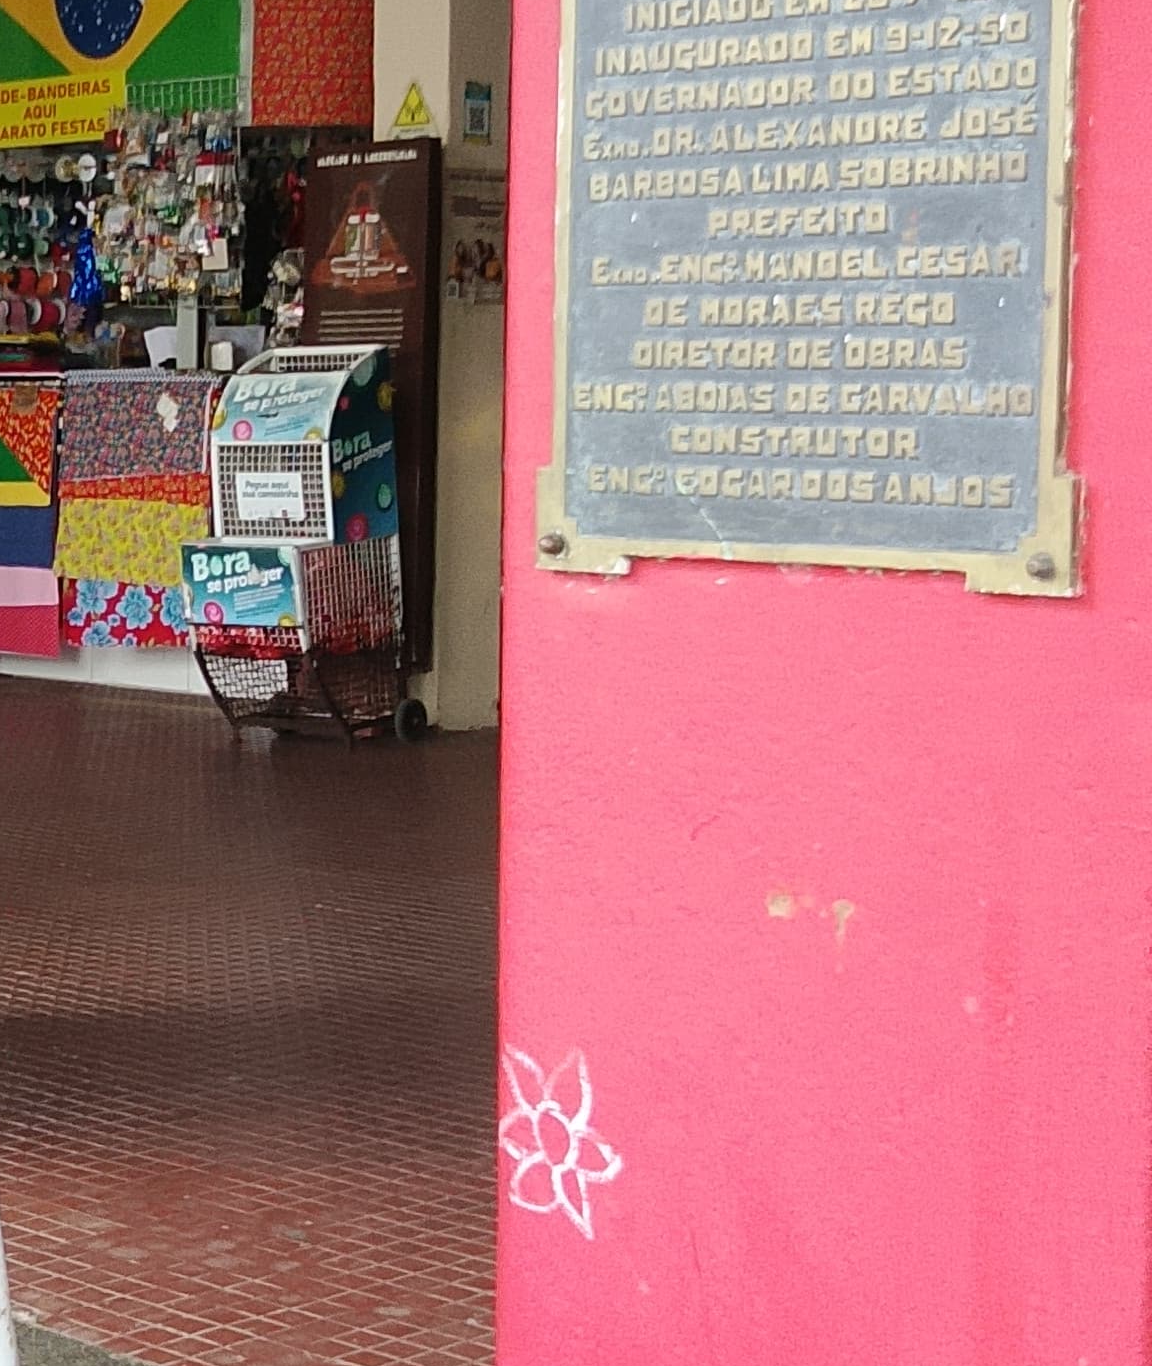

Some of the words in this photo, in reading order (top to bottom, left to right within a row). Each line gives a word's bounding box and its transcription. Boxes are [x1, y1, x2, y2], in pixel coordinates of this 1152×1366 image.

[594, 29, 814, 78] INAUGURADO
[826, 24, 873, 59] EM
[884, 11, 1030, 54] 9-12-50
[584, 72, 815, 121] GOVERNADOR
[828, 68, 876, 103] DO
[887, 57, 1038, 99] ESTADO
[23, 105, 58, 121] AQUI
[51, 117, 106, 137] FESTAS
[710, 106, 928, 155] ALEXANDRE
[939, 90, 1038, 140] JOSÉ
[589, 164, 745, 203] BARBOSA
[750, 159, 832, 195] LIMA
[838, 149, 1029, 191] SOBRINHO
[707, 201, 889, 240] PREFEITO
[744, 246, 890, 283] MANOEL
[643, 295, 689, 328] DE
[700, 291, 843, 328] MORAES
[632, 338, 777, 371] DIRETOR
[786, 338, 833, 371] DE
[843, 336, 968, 371] OBRAS
[785, 383, 831, 415] DE
[839, 383, 1034, 418] CARVALHO
[668, 424, 920, 461] CONSTRUTOR
[799, 469, 876, 504] DOS
[882, 472, 1015, 510] ANJOS
[191, 550, 250, 583] Bora
[223, 566, 285, 595] proger
